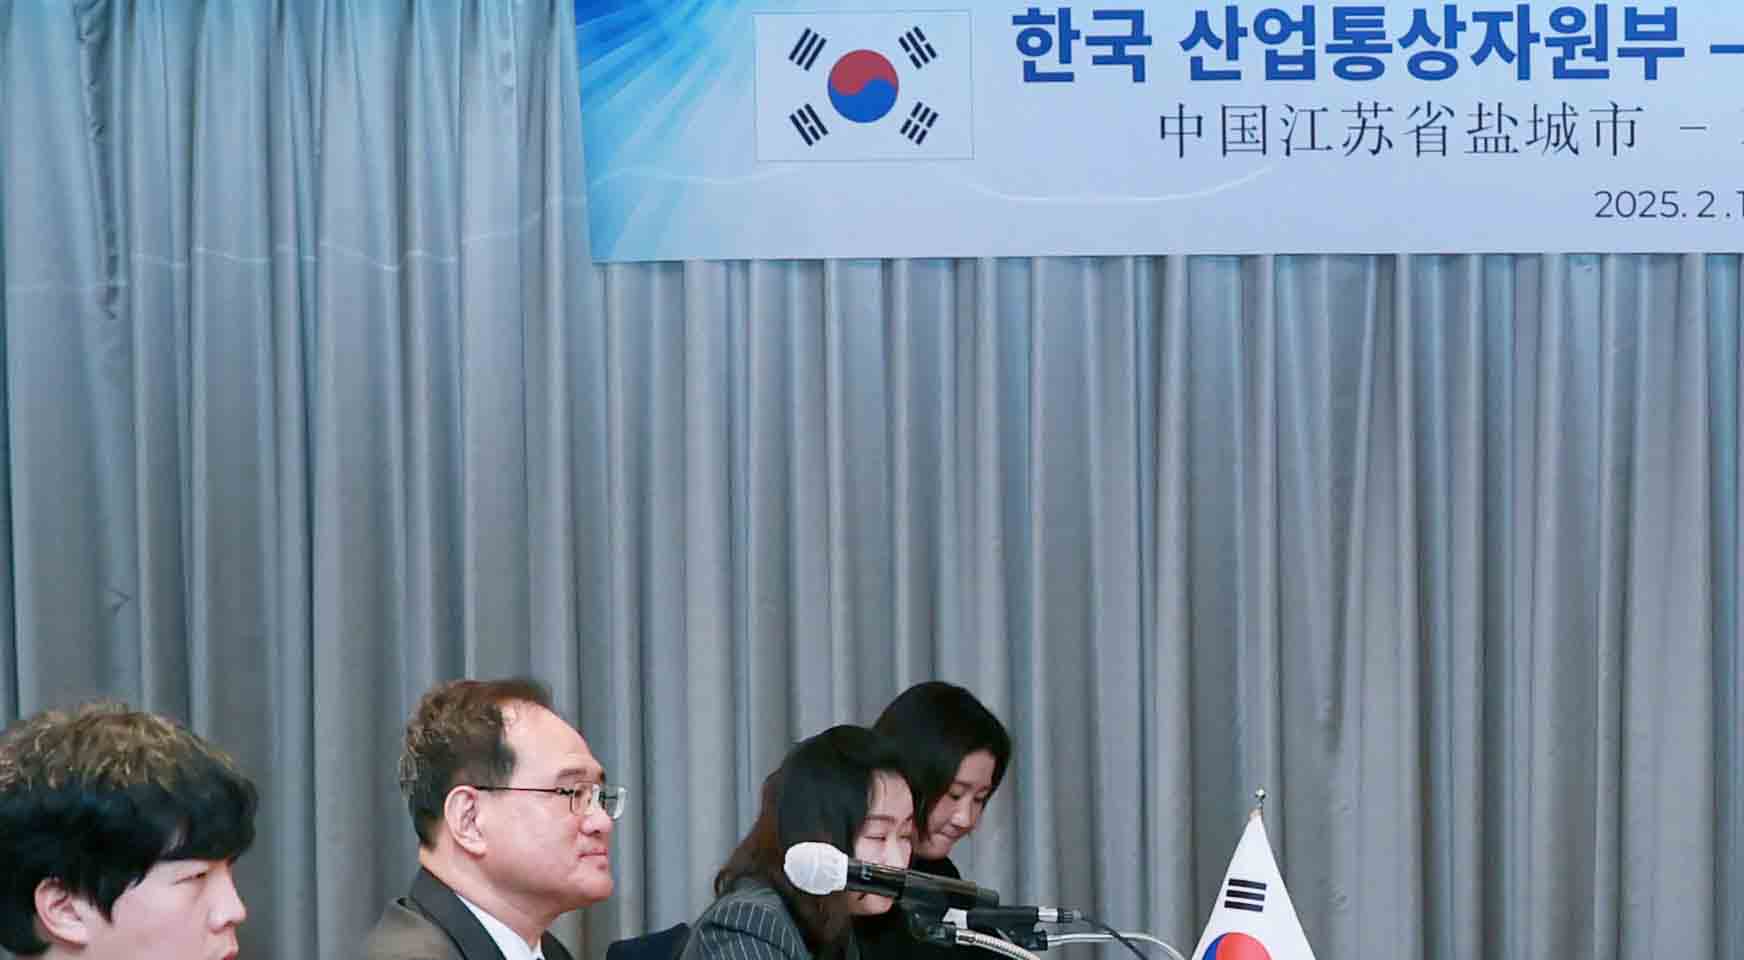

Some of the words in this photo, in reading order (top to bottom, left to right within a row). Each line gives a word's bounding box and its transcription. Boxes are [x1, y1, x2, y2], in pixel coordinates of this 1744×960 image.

[1012, 7, 1152, 83] 한국
[1179, 4, 1686, 82] 산업통상자원부
[1159, 100, 1644, 158] 中国江苏省盐城市
